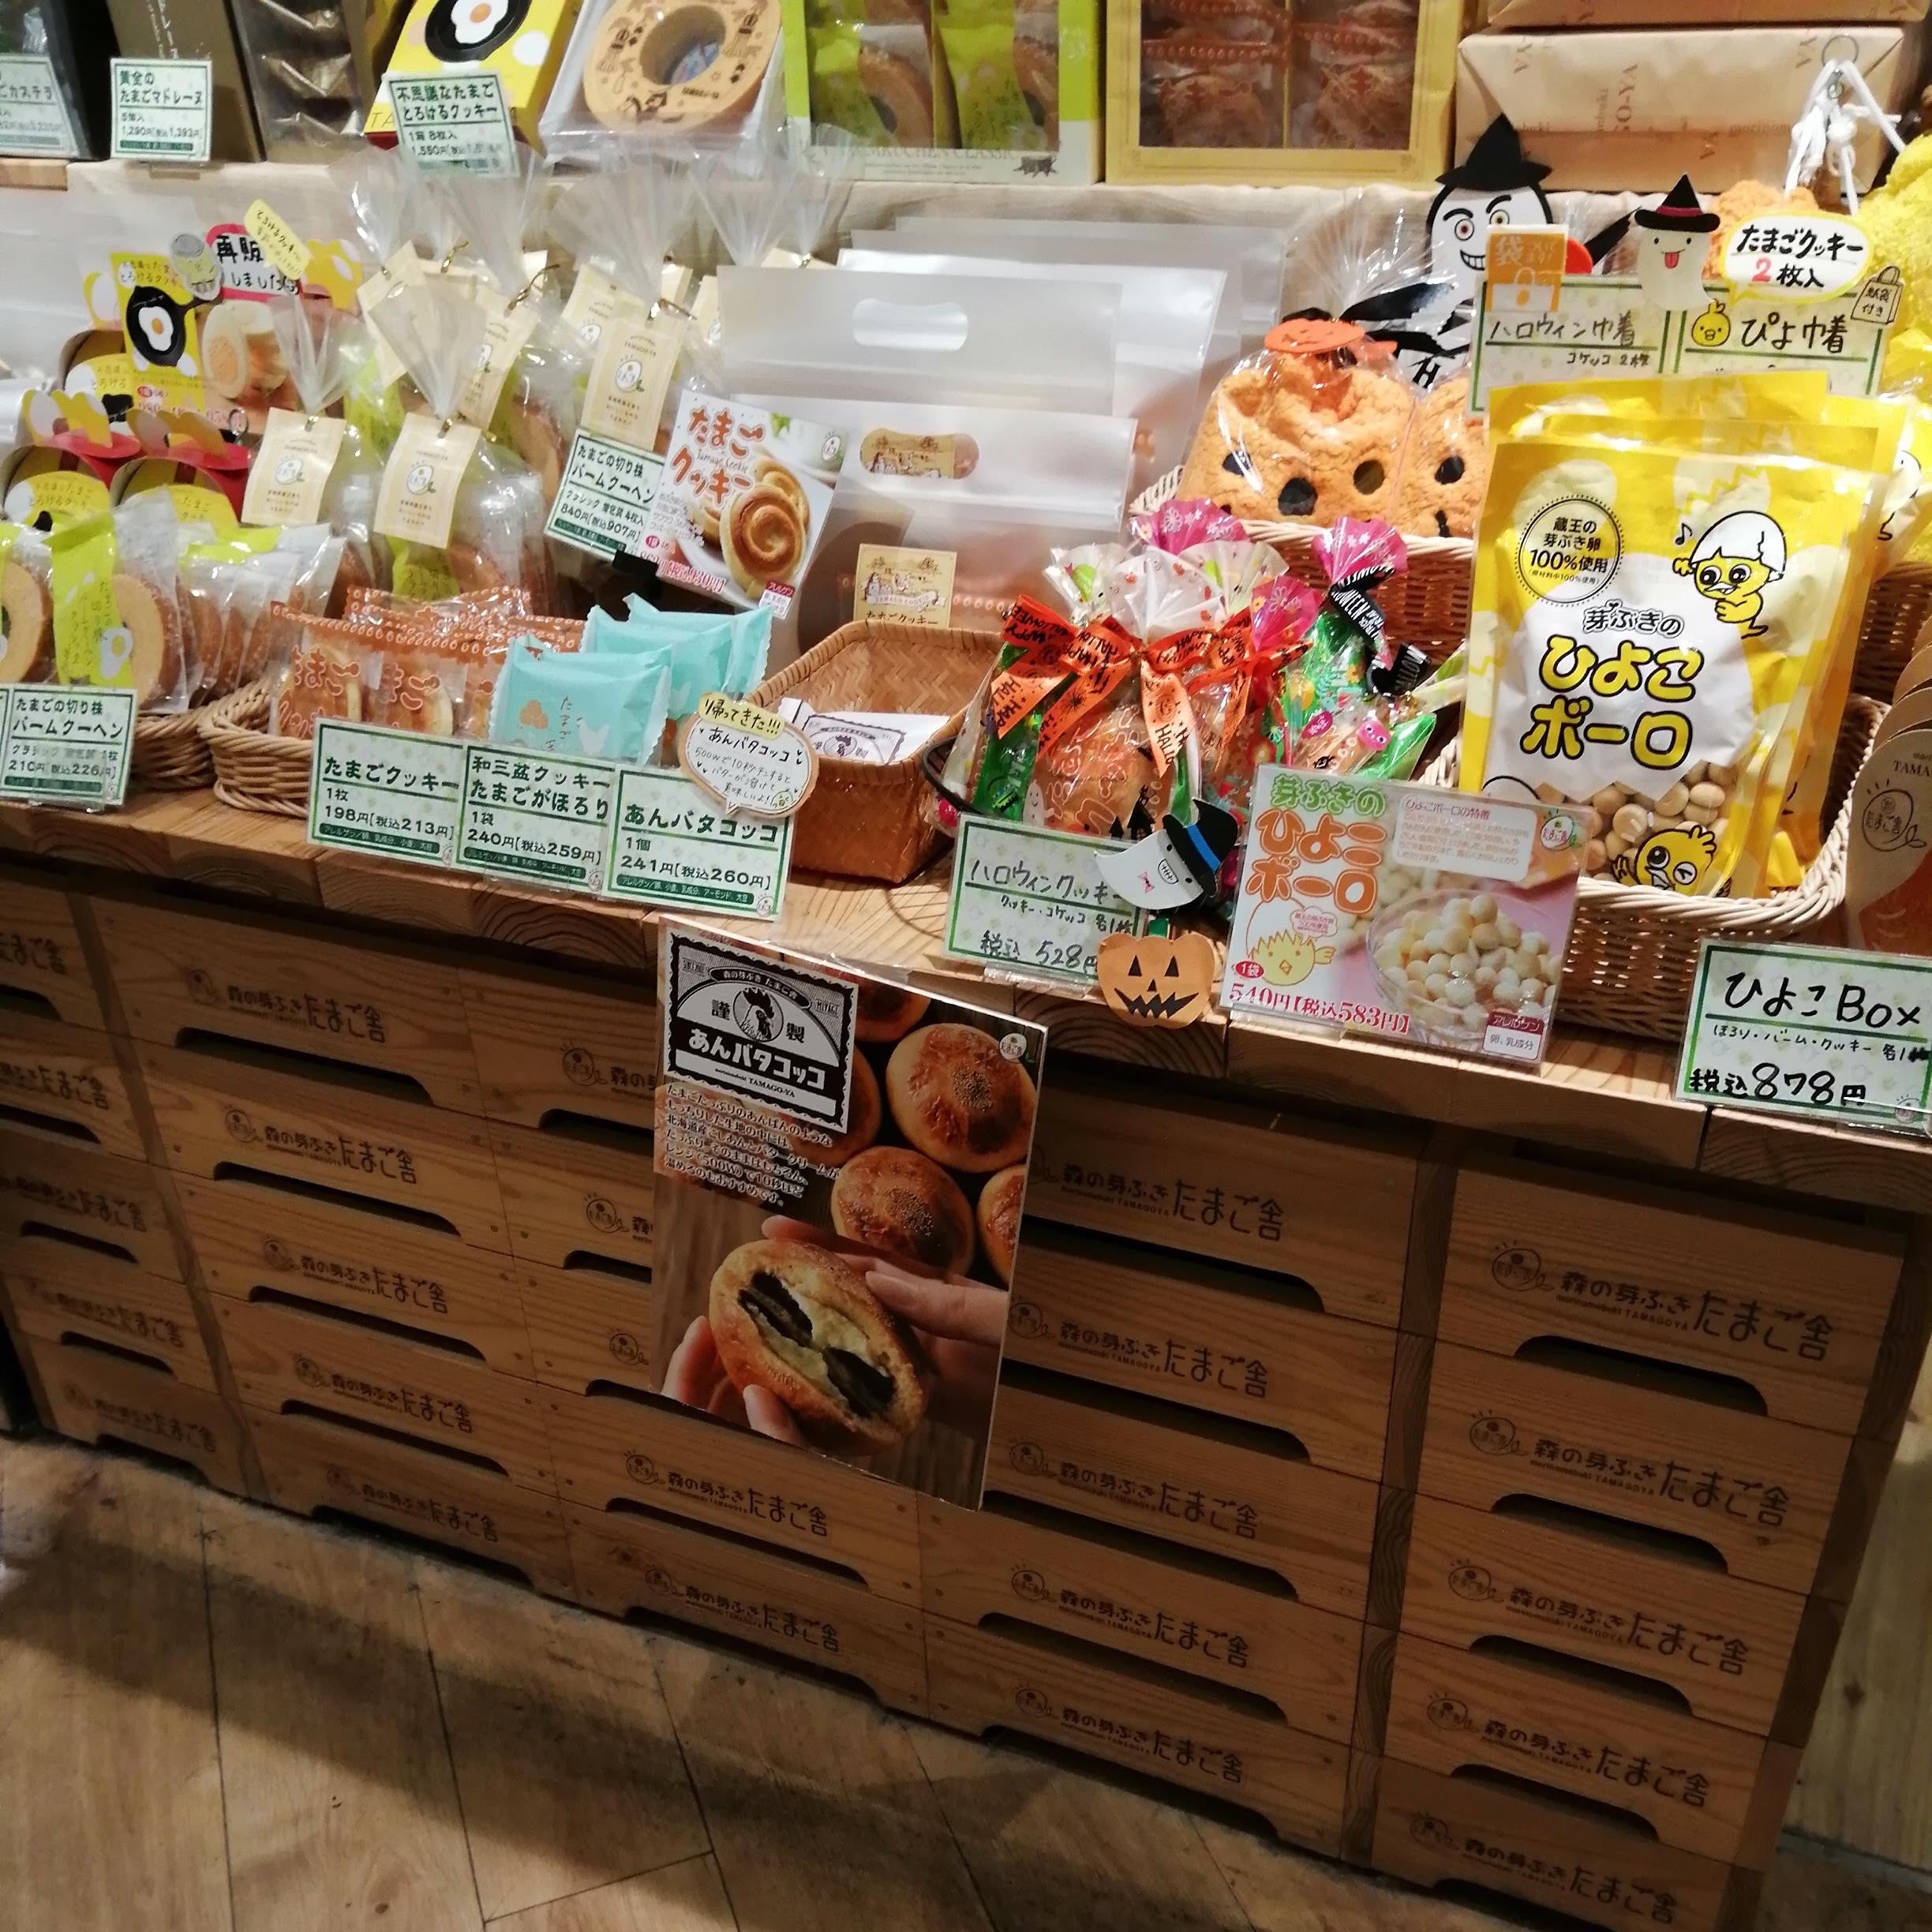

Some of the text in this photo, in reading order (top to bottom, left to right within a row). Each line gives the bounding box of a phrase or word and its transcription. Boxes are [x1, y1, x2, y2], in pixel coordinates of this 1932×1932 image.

[119, 70, 154, 86] 黄金の
[396, 82, 495, 101] 不思議なたまご
[119, 90, 203, 105] たまごマドレーヌ
[403, 103, 498, 122] とろけるクッキー
[1736, 224, 1863, 260] たまごクッキー
[1752, 257, 1825, 288] 2枚入
[1489, 309, 1636, 348] ハロウィン巾着
[1740, 311, 1849, 354] ぴよ巾着
[687, 404, 766, 459] たまご
[577, 444, 645, 479] たまごの切り株
[671, 444, 754, 507] クッキー
[572, 463, 655, 504] バームクーヘン
[1543, 532, 1601, 552] 芽ぶき卵
[1552, 516, 1597, 534] 蔵王の
[1530, 549, 1609, 574] 100%使用
[1582, 597, 1686, 639] 芽ぶきの
[1538, 634, 1705, 702] ひよこ
[15, 697, 103, 716] たまごの切り株
[12, 715, 124, 739] バームクーヘン
[708, 726, 791, 763] あんバタコッコ
[1519, 694, 1693, 771] ボーロ
[323, 756, 460, 792] たまごクッキー
[471, 754, 611, 790] 和三盆クッキー
[1894, 759, 1932, 778] TAMA
[326, 787, 350, 803] 1枚
[470, 778, 609, 820] たまごがほろり
[1270, 773, 1388, 818] 芽ぶきの
[324, 804, 455, 841] 198円[税込213円]
[472, 811, 494, 827] 1袋
[623, 803, 779, 844] あんバタコッコ
[466, 828, 602, 866] 240円[税込259円]
[625, 837, 651, 852] 1個
[1256, 807, 1388, 868] ひよこ
[620, 855, 772, 891] 241円[税込260円]
[1245, 856, 1380, 915] ボーロ
[979, 929, 1020, 960] 税込
[1240, 962, 1264, 978] 1袋
[688, 1027, 826, 1091] あんバタコッコ
[749, 1077, 796, 1099] TAMAGO-YA
